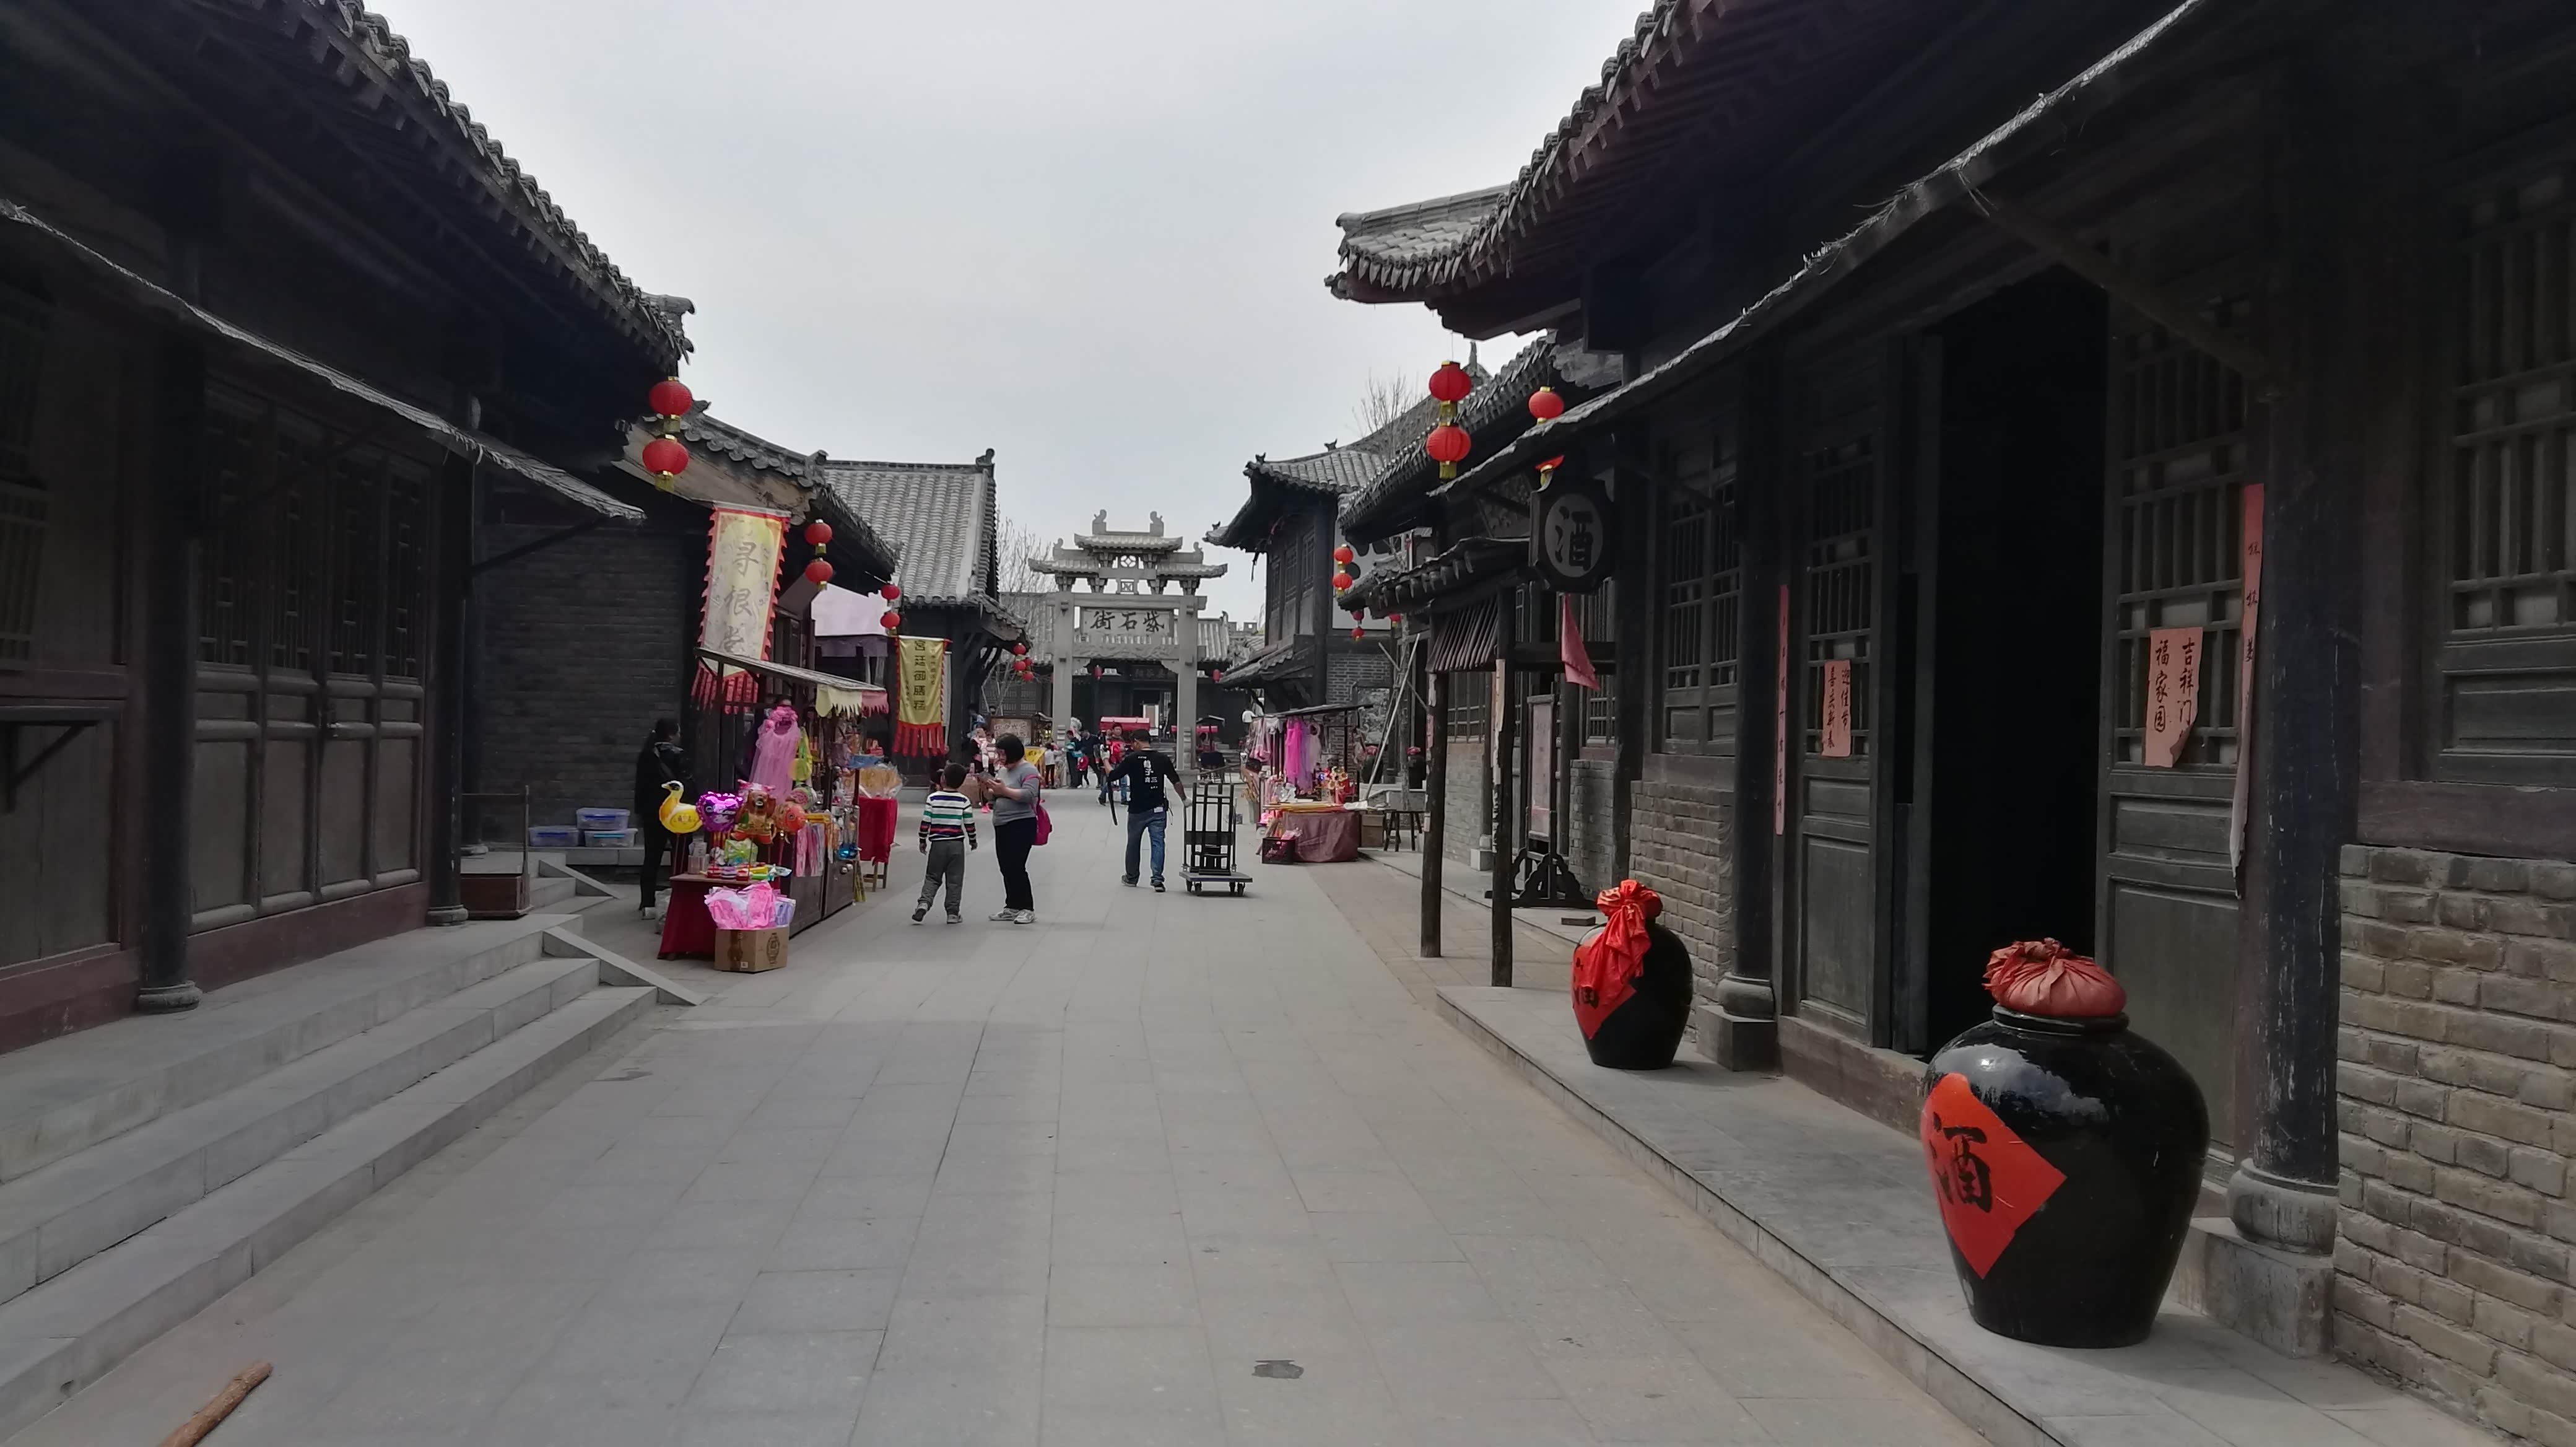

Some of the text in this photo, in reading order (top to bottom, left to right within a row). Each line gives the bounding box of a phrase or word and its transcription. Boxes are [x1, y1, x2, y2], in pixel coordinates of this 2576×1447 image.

[1556, 505, 1593, 572] 酒
[1089, 610, 1165, 633] 紫石街
[2154, 639, 2170, 733] 福家园
[2177, 637, 2196, 738] 吉祥门
[1929, 1111, 1994, 1215] 酒
